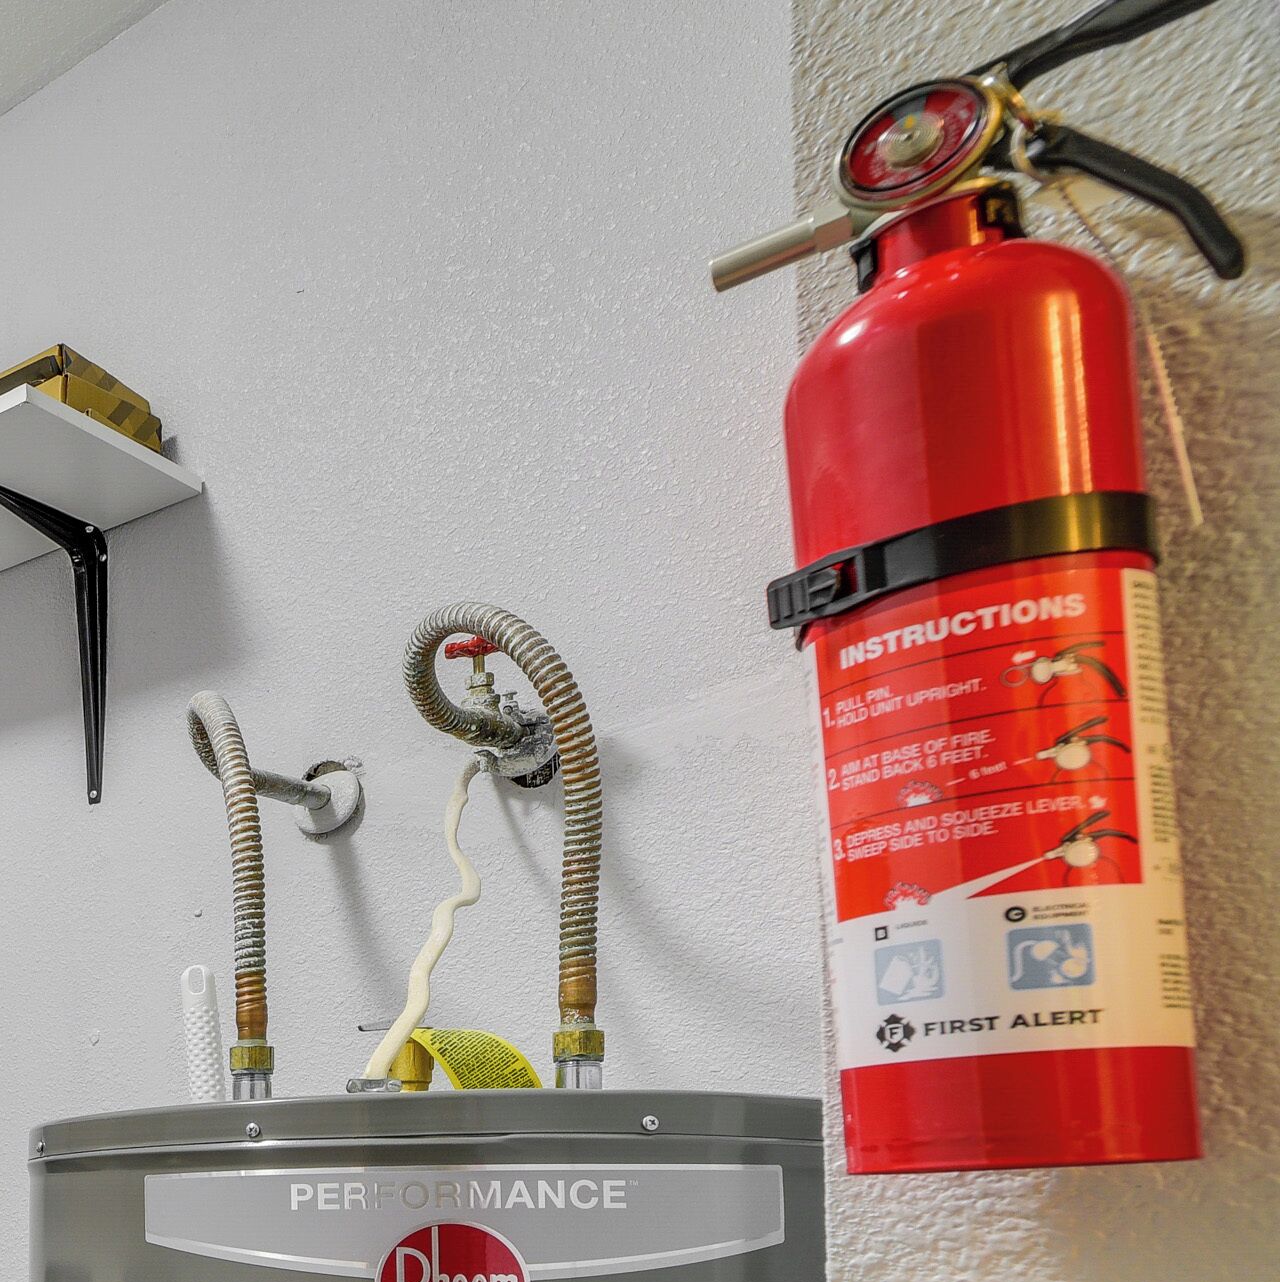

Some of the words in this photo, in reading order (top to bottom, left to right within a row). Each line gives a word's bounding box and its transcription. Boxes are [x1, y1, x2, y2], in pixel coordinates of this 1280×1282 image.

[840, 593, 1086, 670] INSTRUCTIONS
[836, 708, 868, 728] HOLD
[870, 696, 903, 719] UNIT
[905, 678, 987, 707] UPRIGHT.
[836, 695, 865, 715] PULL
[842, 760, 862, 778] AIM
[862, 754, 880, 770] AT
[881, 744, 922, 766] BASE
[923, 737, 949, 754] OF
[950, 729, 996, 748] FIRE.
[842, 770, 881, 791] STAND
[882, 759, 924, 779] BACK
[926, 755, 938, 769] 6
[941, 745, 989, 766] FEET.
[968, 767, 980, 779] 6
[980, 761, 1007, 776] feet
[846, 823, 901, 849] DEPRESS
[904, 816, 938, 833] AND
[941, 802, 1024, 826] SQUEEZE
[847, 841, 888, 863] SWEEP
[890, 833, 924, 852] SIDE
[927, 829, 949, 843] TO
[952, 821, 999, 840] SIDE.
[924, 1015, 1001, 1037] FIRST
[1009, 1009, 1105, 1030] ALERT
[289, 1180, 627, 1211] PERFORMANCE
